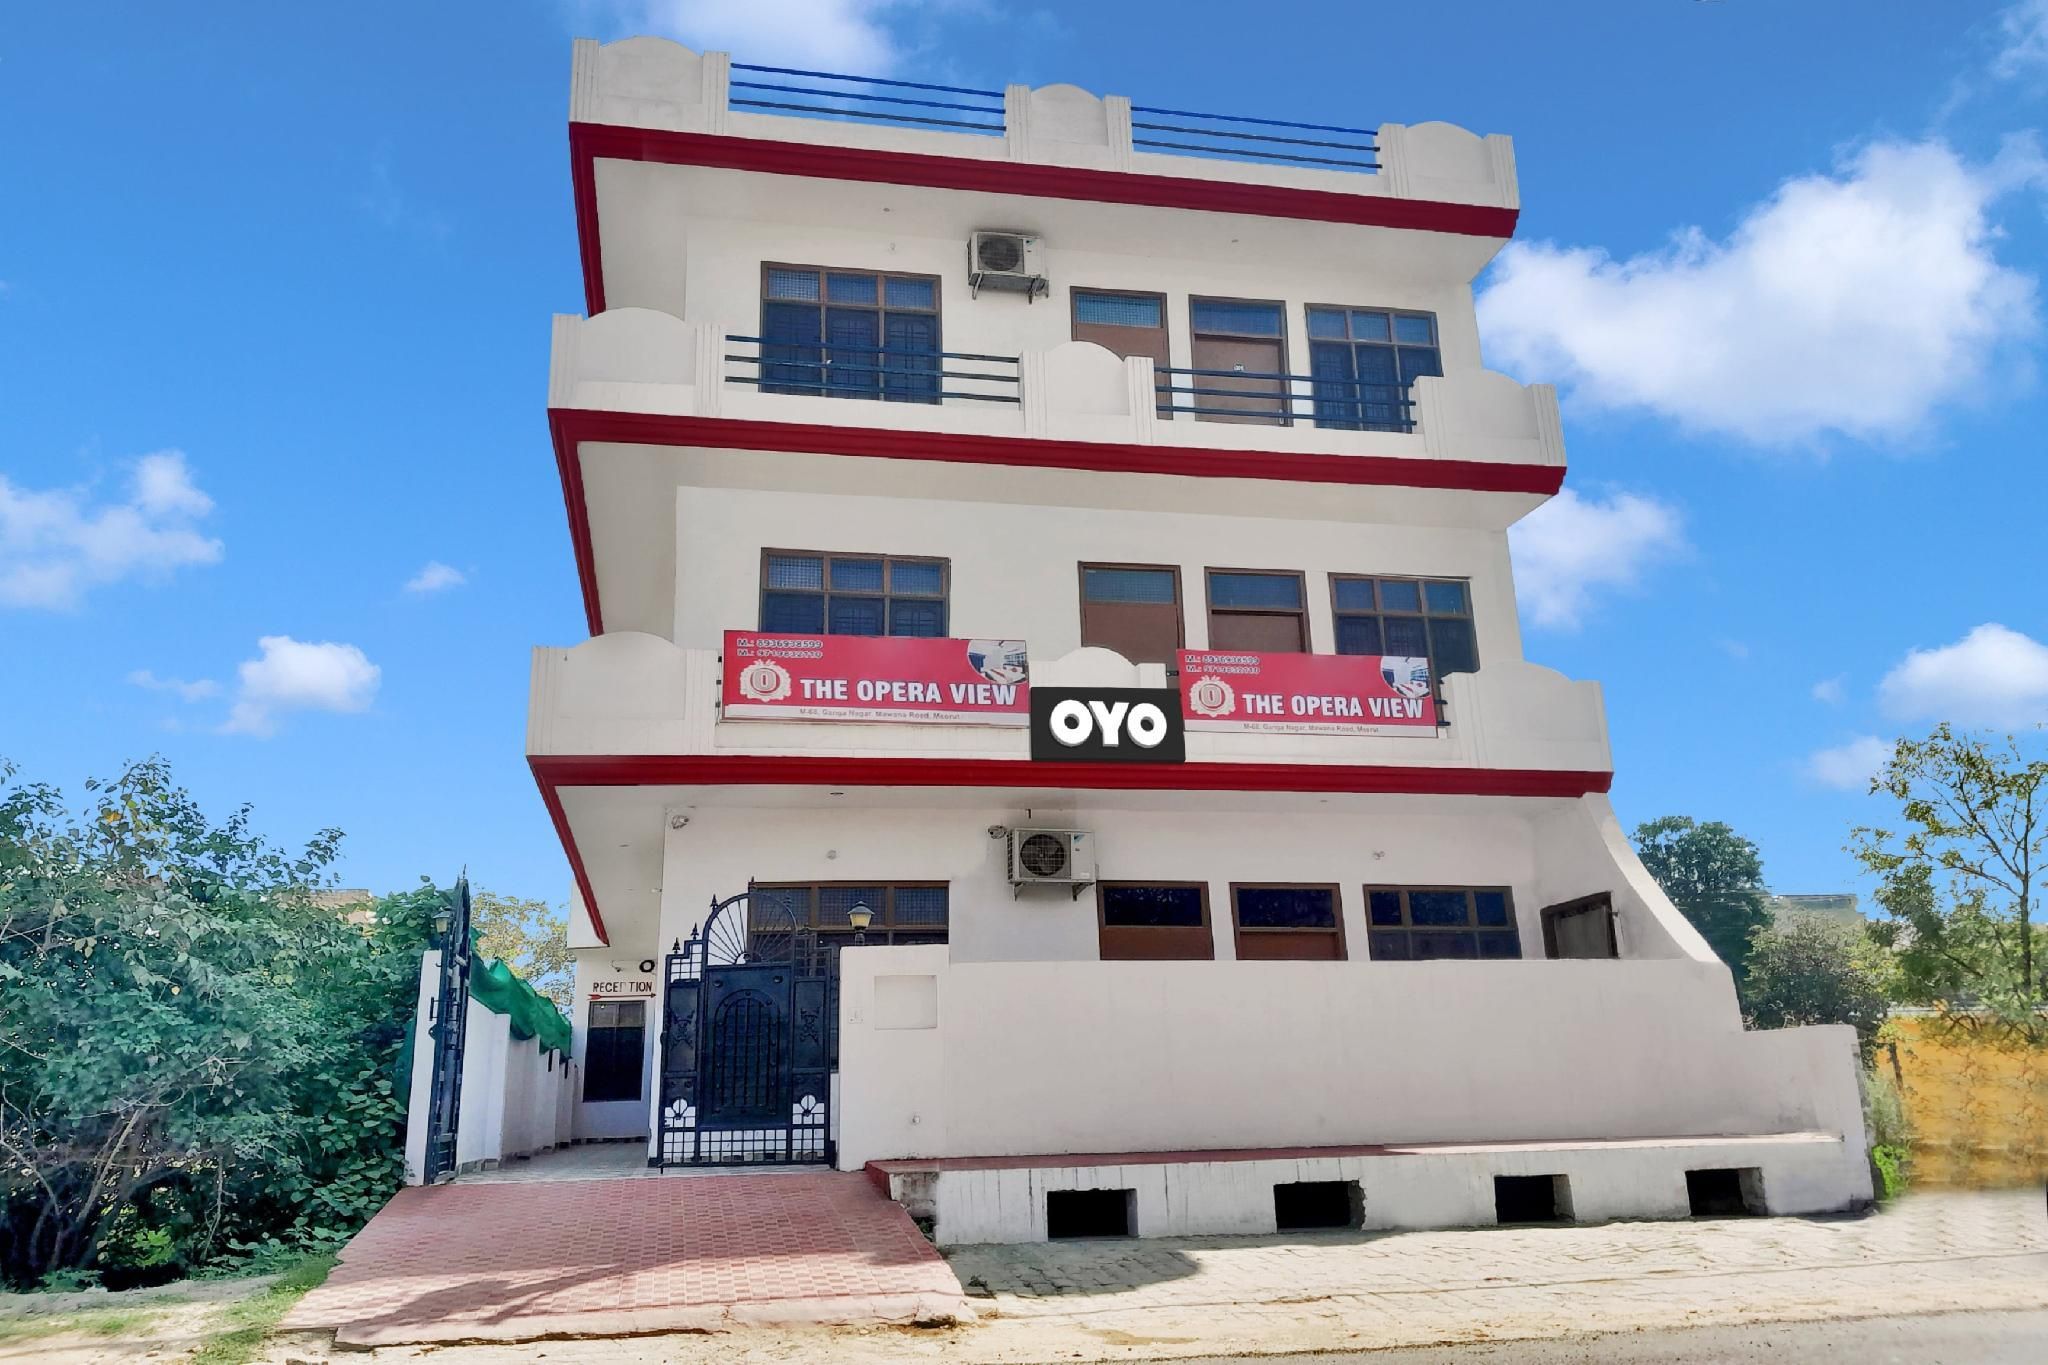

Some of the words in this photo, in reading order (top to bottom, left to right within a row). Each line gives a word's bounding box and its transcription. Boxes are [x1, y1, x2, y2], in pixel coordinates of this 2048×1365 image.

[800, 679, 848, 700] THE
[856, 680, 943, 703] OPERA
[949, 682, 1017, 705] VIEW
[1242, 694, 1285, 715] THE
[1291, 695, 1363, 717] OPERA
[1368, 697, 1423, 719] VIEW
[1049, 699, 1168, 749] OYO
